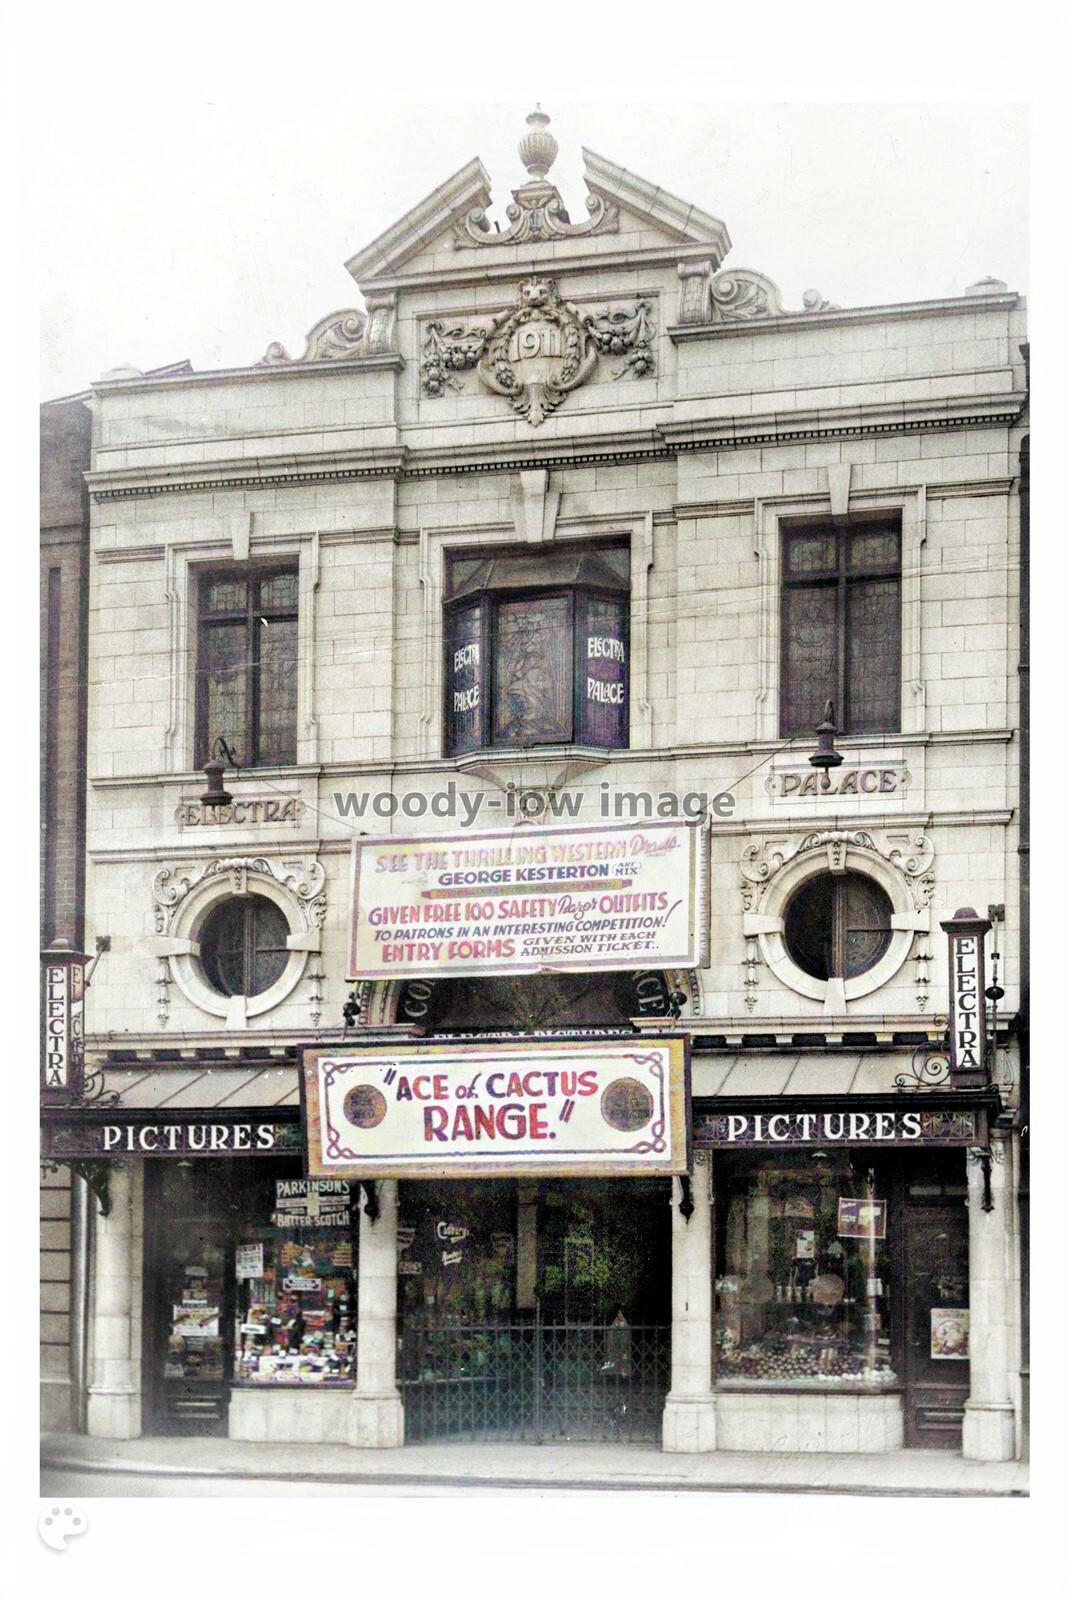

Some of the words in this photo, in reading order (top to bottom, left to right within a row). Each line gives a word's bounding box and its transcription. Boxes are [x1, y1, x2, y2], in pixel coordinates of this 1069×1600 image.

[514, 329, 562, 361] 1911
[454, 643, 480, 673] ELECTRA
[587, 637, 625, 662] ELECTRA
[453, 684, 480, 713] PALACE
[587, 677, 625, 704] PALACE
[185, 800, 298, 826] ELECTRA
[375, 852, 408, 873] SEE
[414, 850, 448, 870] THE
[452, 844, 548, 868] THRILLING
[550, 840, 627, 863] WESTERN
[438, 869, 511, 886] GEORGE
[516, 863, 609, 881] KESTERTON
[368, 905, 421, 926] GIVEN
[424, 902, 461, 923] FREE
[465, 901, 494, 921] 100
[498, 898, 557, 919] SAFETY
[558, 895, 597, 920] Razor
[599, 891, 668, 914] OUTFITS
[374, 929, 391, 941] TO
[394, 927, 454, 940] PATRONS
[457, 926, 470, 938] IN
[472, 925, 490, 937] AN
[493, 921, 573, 936] INTERESTING
[523, 935, 576, 945] GIVEN
[580, 933, 617, 943] WITH
[620, 931, 656, 940] EACH
[382, 941, 443, 962] ENTRY
[448, 938, 516, 959] FORMS
[520, 944, 592, 956] ADMISSION
[955, 936, 978, 1067] ELECTRA
[48, 967, 65, 1085] ELECTRA
[486, 1071, 599, 1099] CACTUS
[103, 1125, 275, 1150] PICTURES
[727, 1113, 922, 1141] PICTURES
